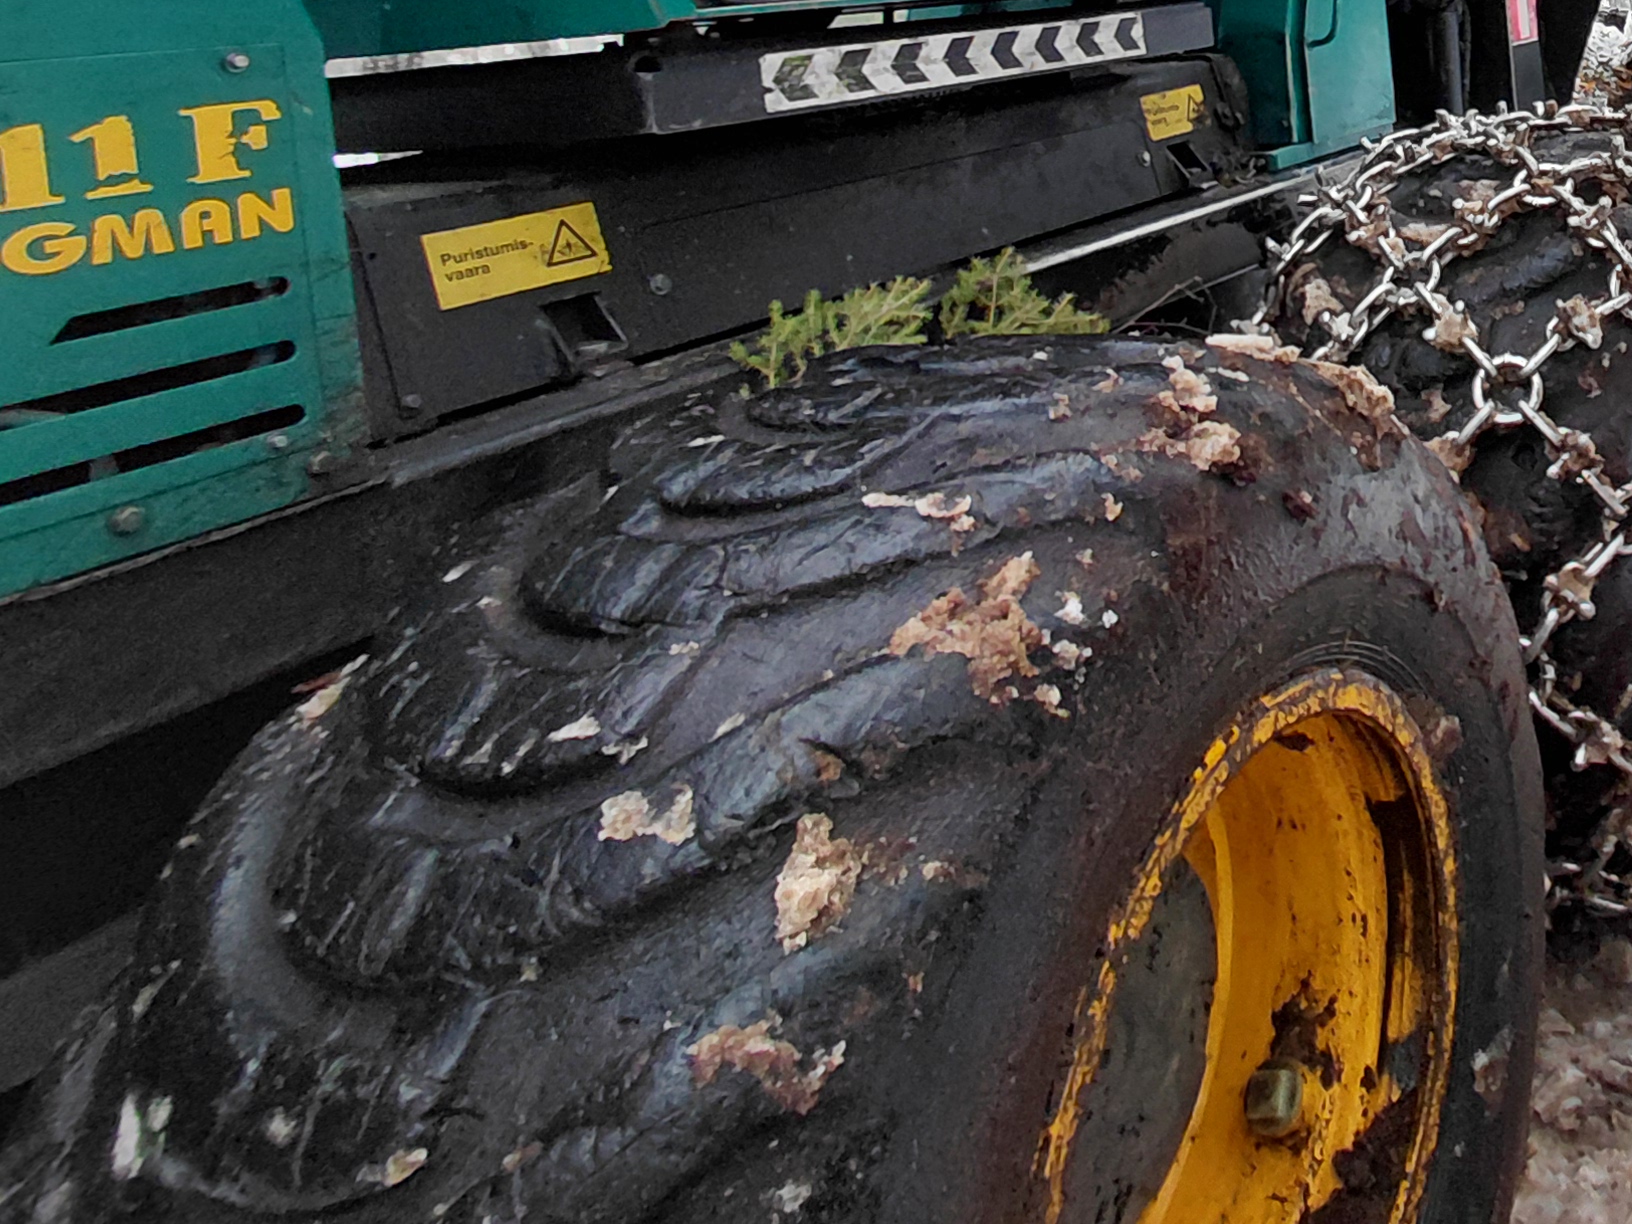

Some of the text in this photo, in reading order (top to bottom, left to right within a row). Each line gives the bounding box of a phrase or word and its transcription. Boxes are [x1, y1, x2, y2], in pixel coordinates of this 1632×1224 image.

[177, 99, 283, 184] F
[0, 187, 294, 275] GMAN
[440, 238, 534, 267] Puristumis-
[445, 263, 491, 282] vaara
